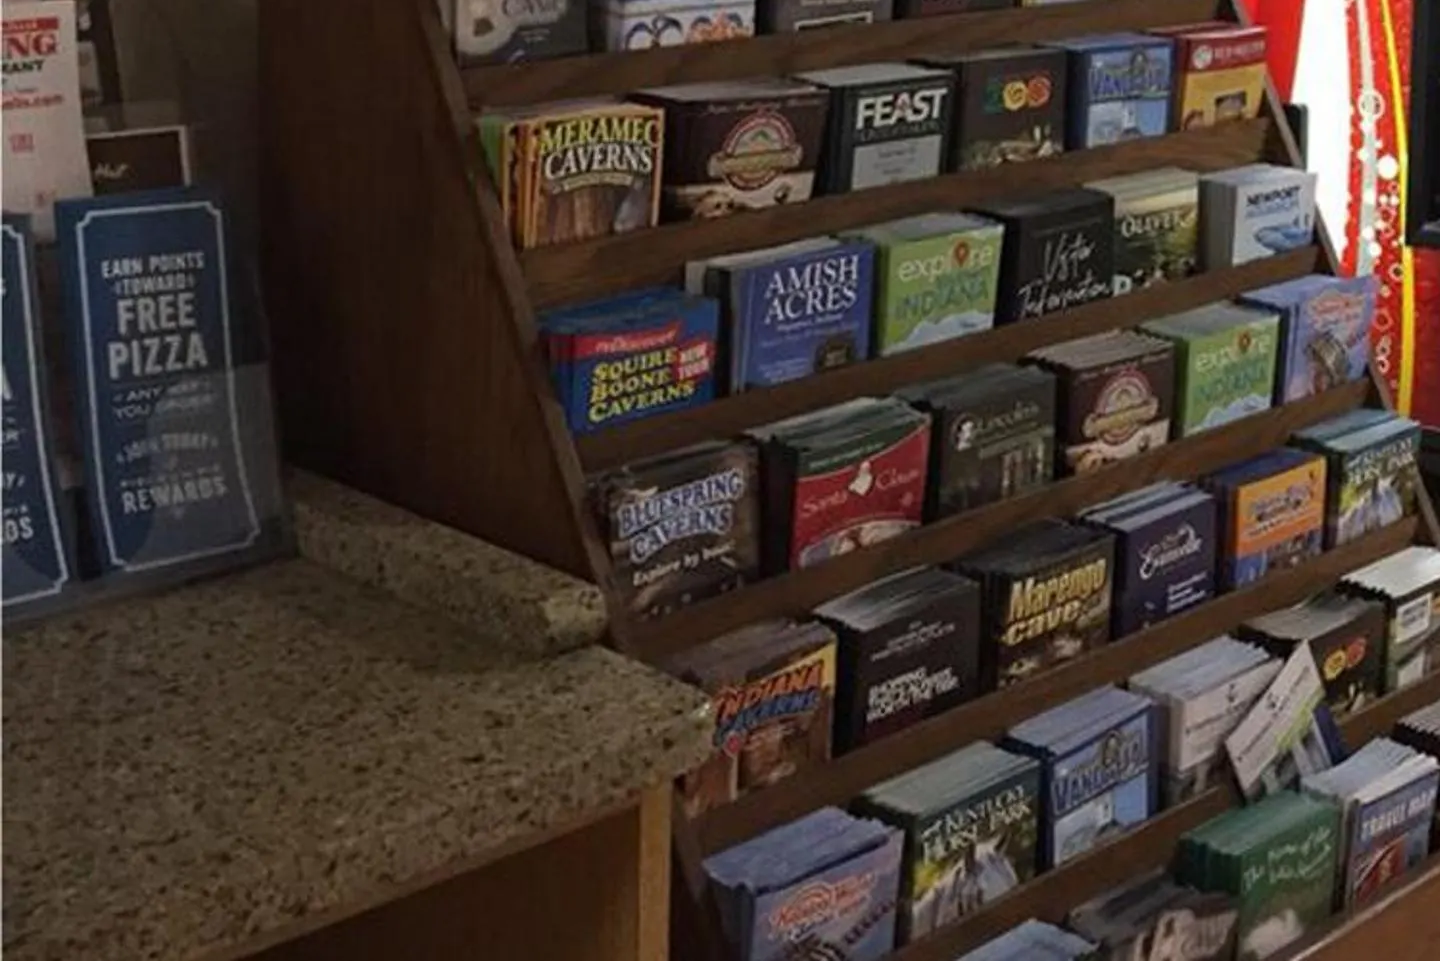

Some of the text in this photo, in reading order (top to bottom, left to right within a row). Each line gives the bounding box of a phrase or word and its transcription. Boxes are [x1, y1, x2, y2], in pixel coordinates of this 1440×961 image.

[856, 88, 948, 131] FEAST
[540, 114, 660, 155] MERAMEC
[544, 143, 653, 181] CAVERNS
[101, 251, 205, 279] EARN POINTS
[123, 273, 187, 296] TOWARD
[765, 254, 859, 298] AMISH
[116, 292, 196, 337] FREE
[765, 286, 857, 324] ACRES
[108, 332, 209, 381] PIZZA
[593, 347, 678, 381] SQUIRE
[589, 380, 695, 422] CAVERNS
[590, 368, 674, 403] BOONE
[617, 467, 745, 539] BLUESPRING
[629, 501, 734, 564] CAVERNS
[1010, 559, 1107, 621] Marengo
[1002, 600, 1082, 646] cave
[714, 659, 823, 725] INDIANA
